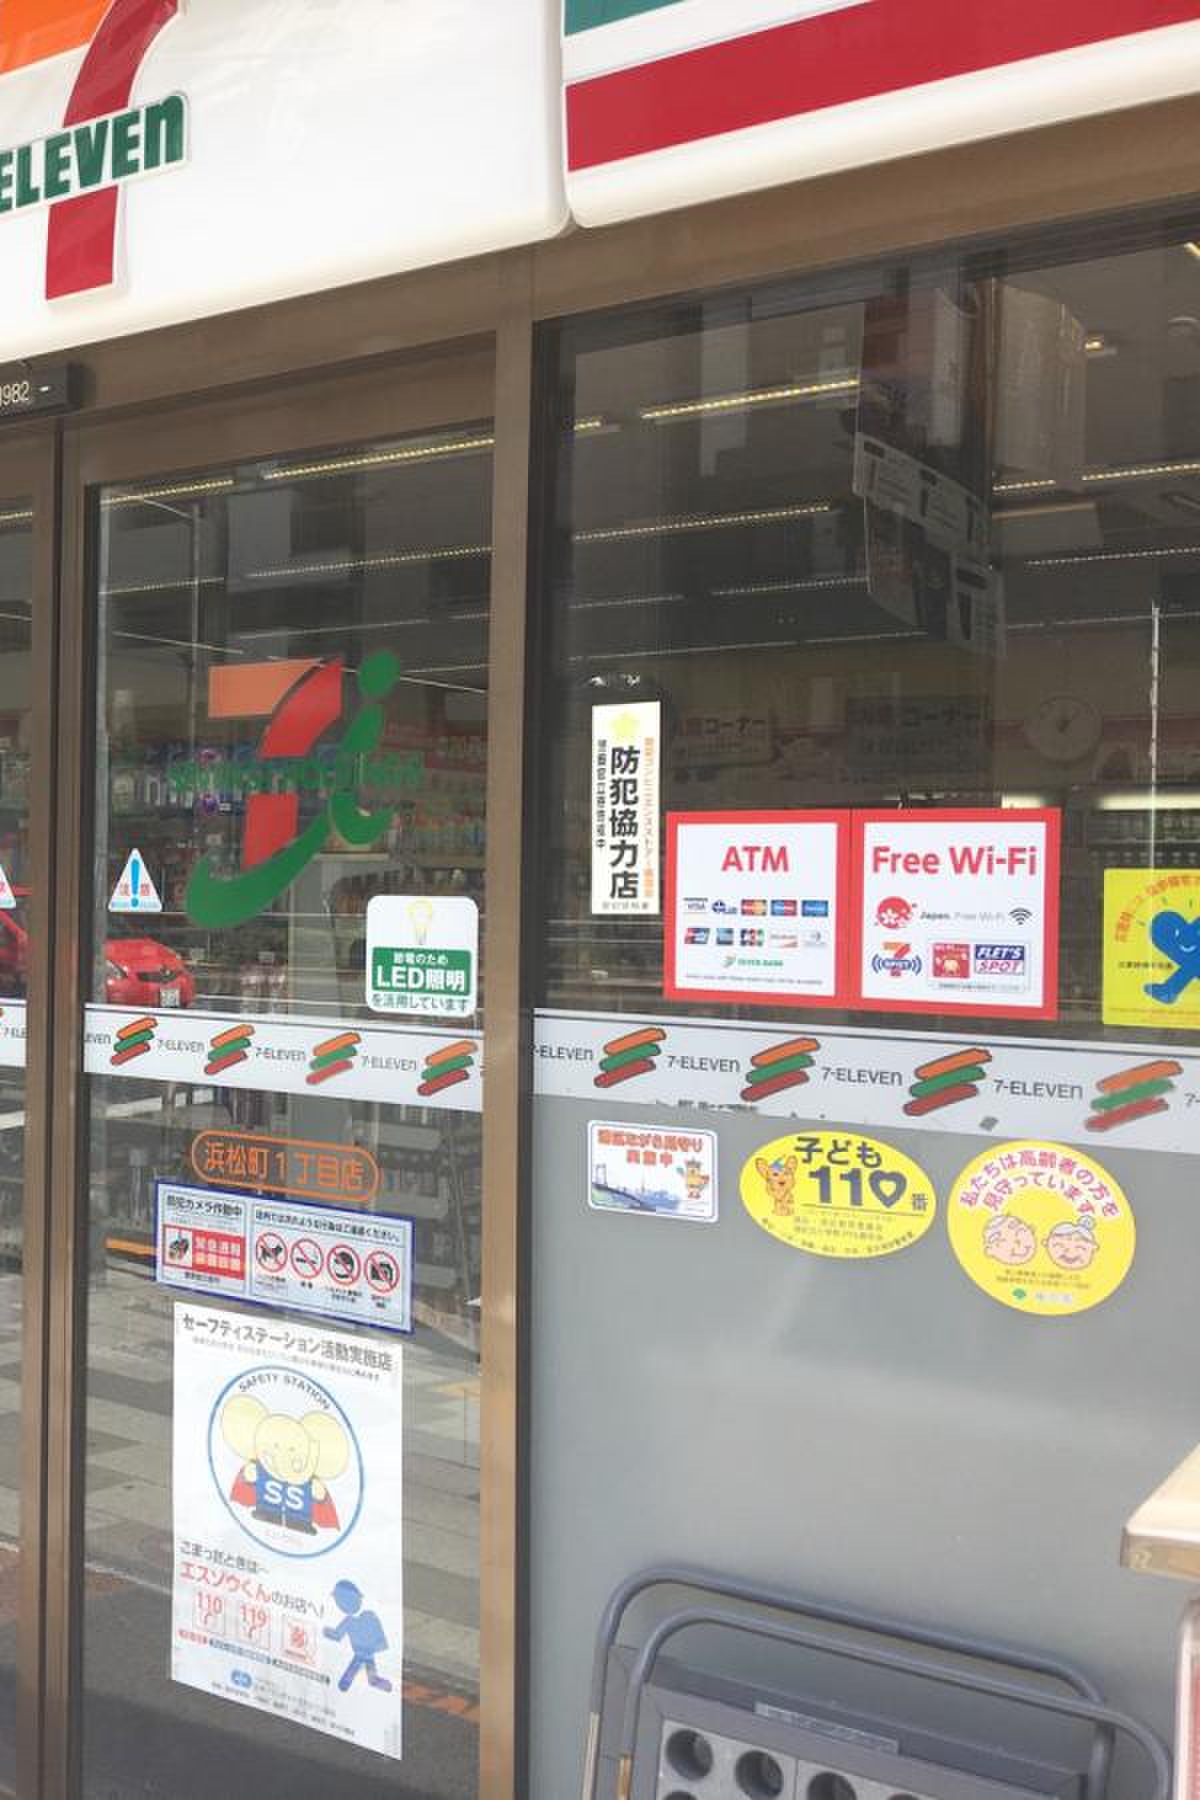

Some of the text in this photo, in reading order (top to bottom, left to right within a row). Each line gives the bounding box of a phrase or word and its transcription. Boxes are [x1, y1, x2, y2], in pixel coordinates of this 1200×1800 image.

[609, 745, 641, 899] 防犯協力店
[721, 845, 790, 873] ATM
[872, 845, 1037, 876] Free Wi-Fi
[376, 964, 466, 993] LED照明
[205, 1141, 366, 1191] 浜松町1丁目店
[794, 1136, 883, 1168] 子ども
[263, 1481, 305, 1511] SS
